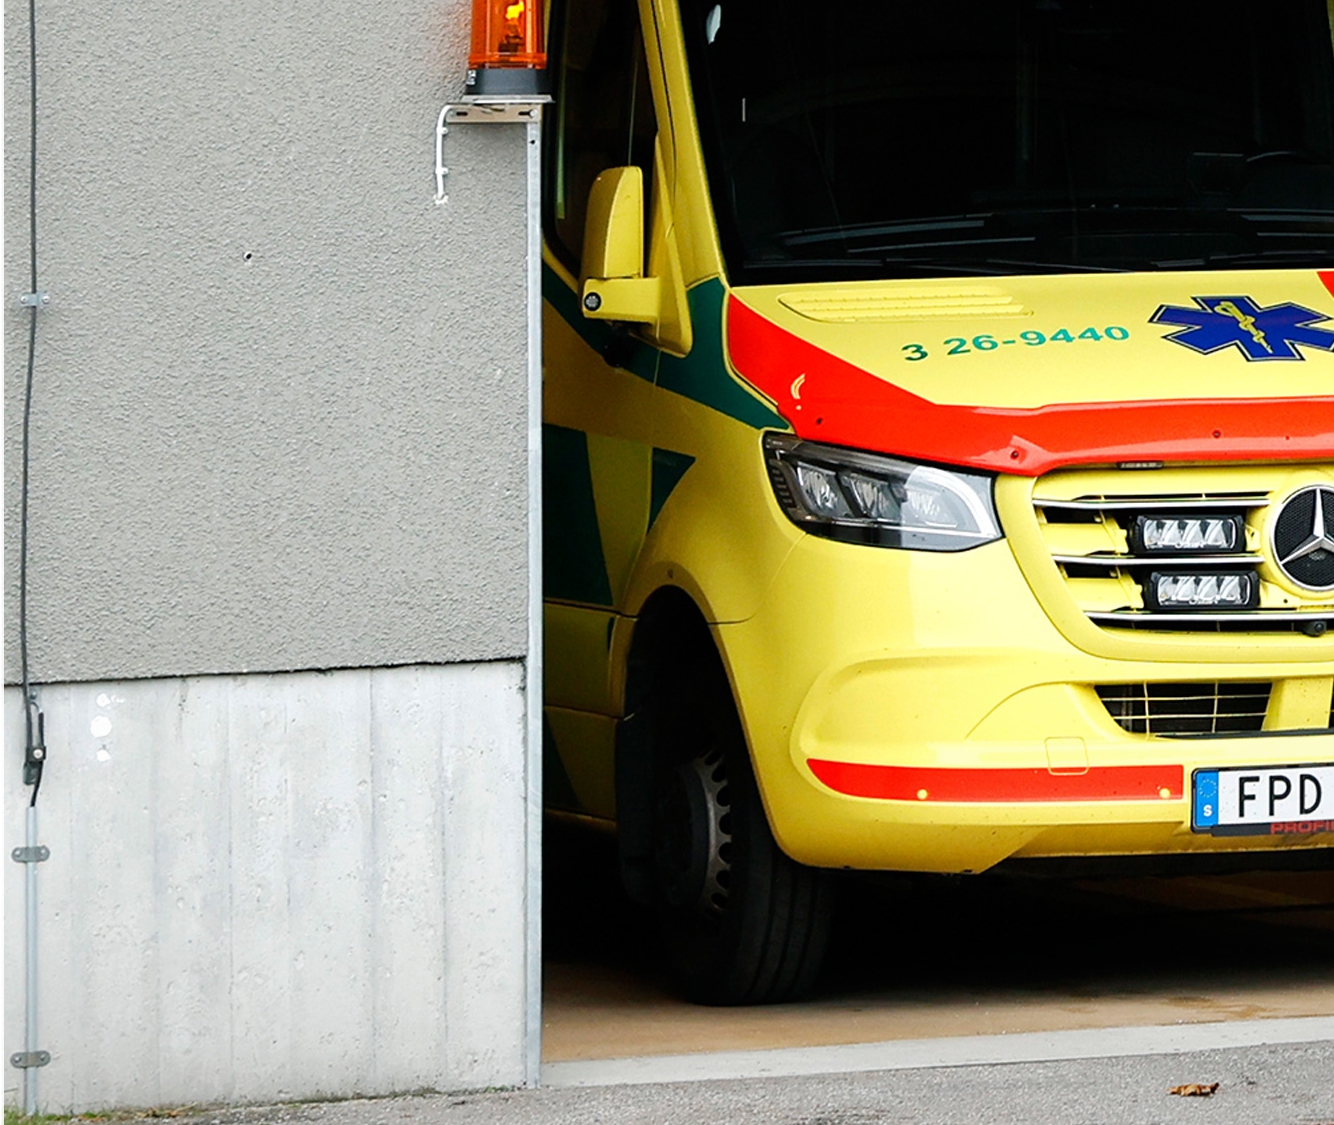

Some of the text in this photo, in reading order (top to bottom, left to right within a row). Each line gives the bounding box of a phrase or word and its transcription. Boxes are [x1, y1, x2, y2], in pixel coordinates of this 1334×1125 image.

[901, 325, 1130, 362] 3 26-9440
[1203, 804, 1213, 817] S
[1238, 773, 1323, 818] FPD
